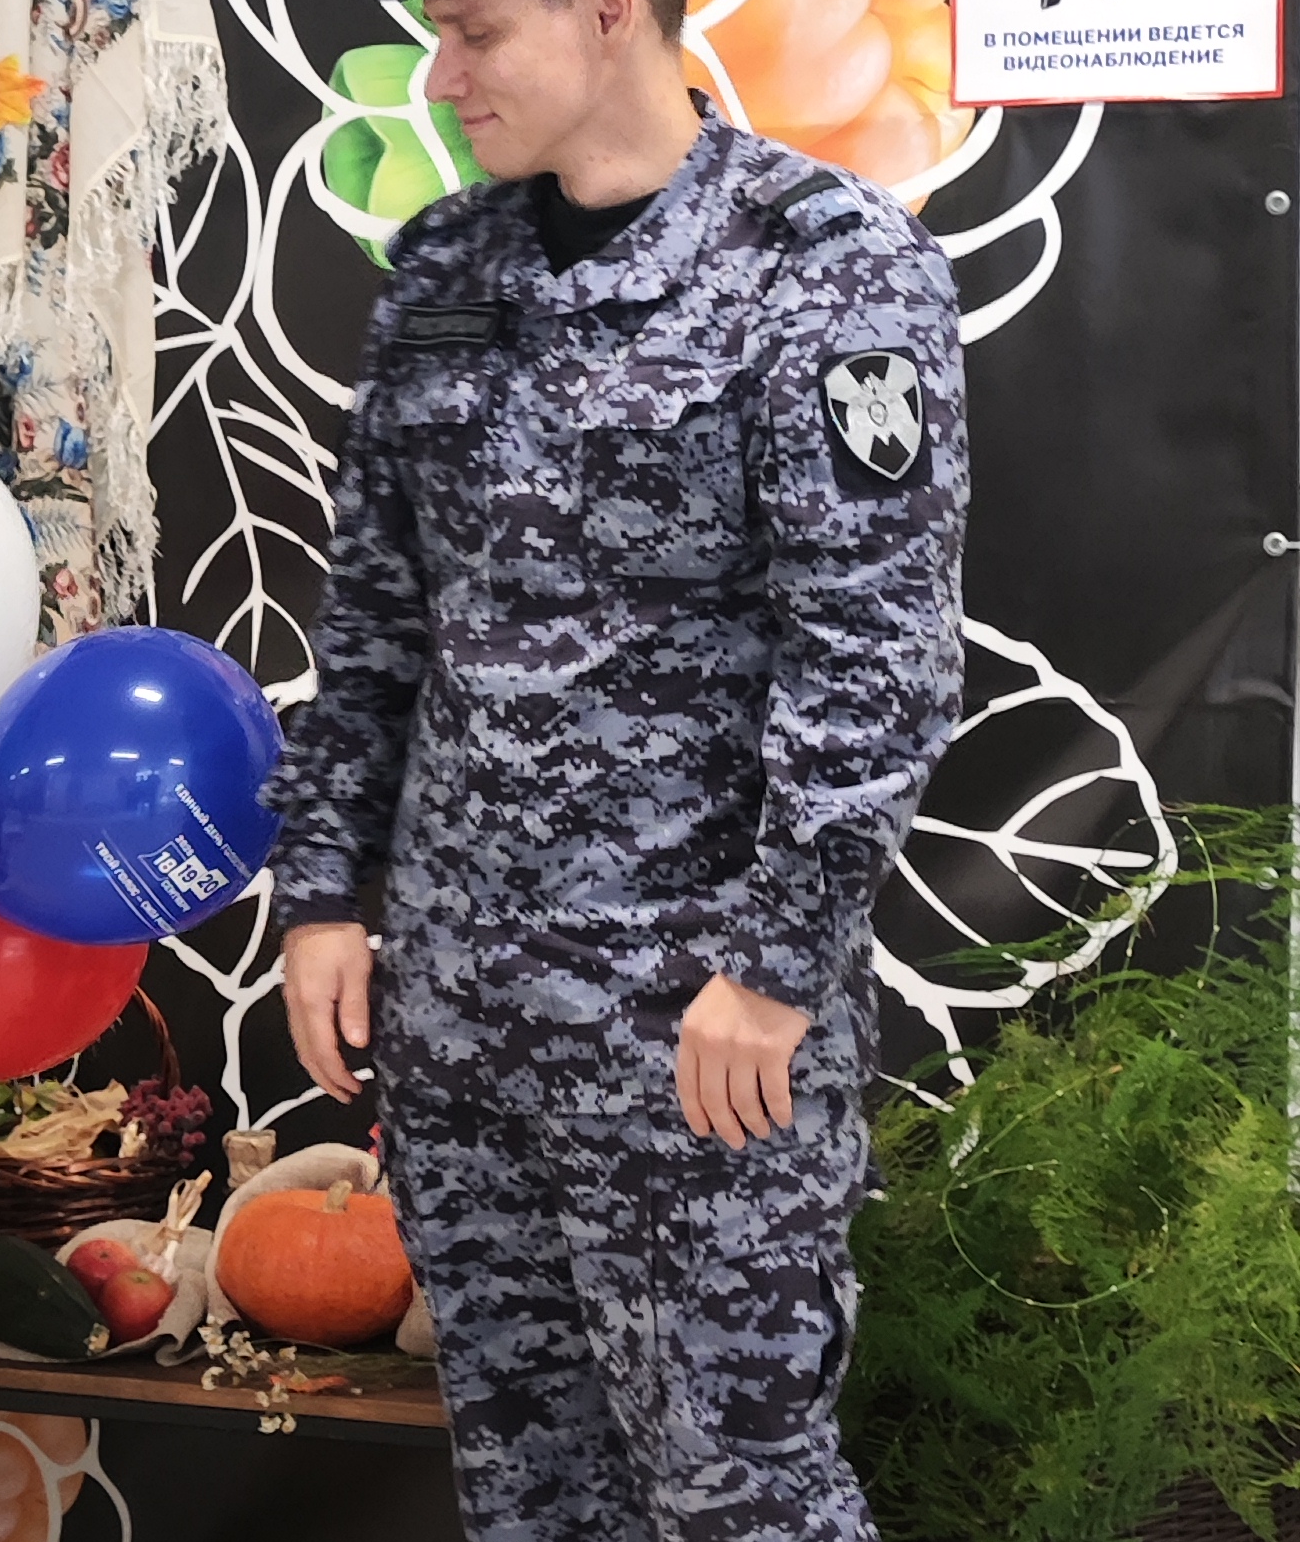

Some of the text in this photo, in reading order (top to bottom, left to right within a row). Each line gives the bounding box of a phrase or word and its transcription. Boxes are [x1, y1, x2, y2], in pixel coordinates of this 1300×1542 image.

[984, 23, 1244, 47] В ПОМЕЩЕНИИ ВЕДЕТСЯ
[1003, 48, 1224, 71] ВИДЕОНАБЛЮДЕНИЕ
[153, 851, 177, 875] 18
[177, 863, 198, 884] 19
[197, 873, 220, 895] 20
